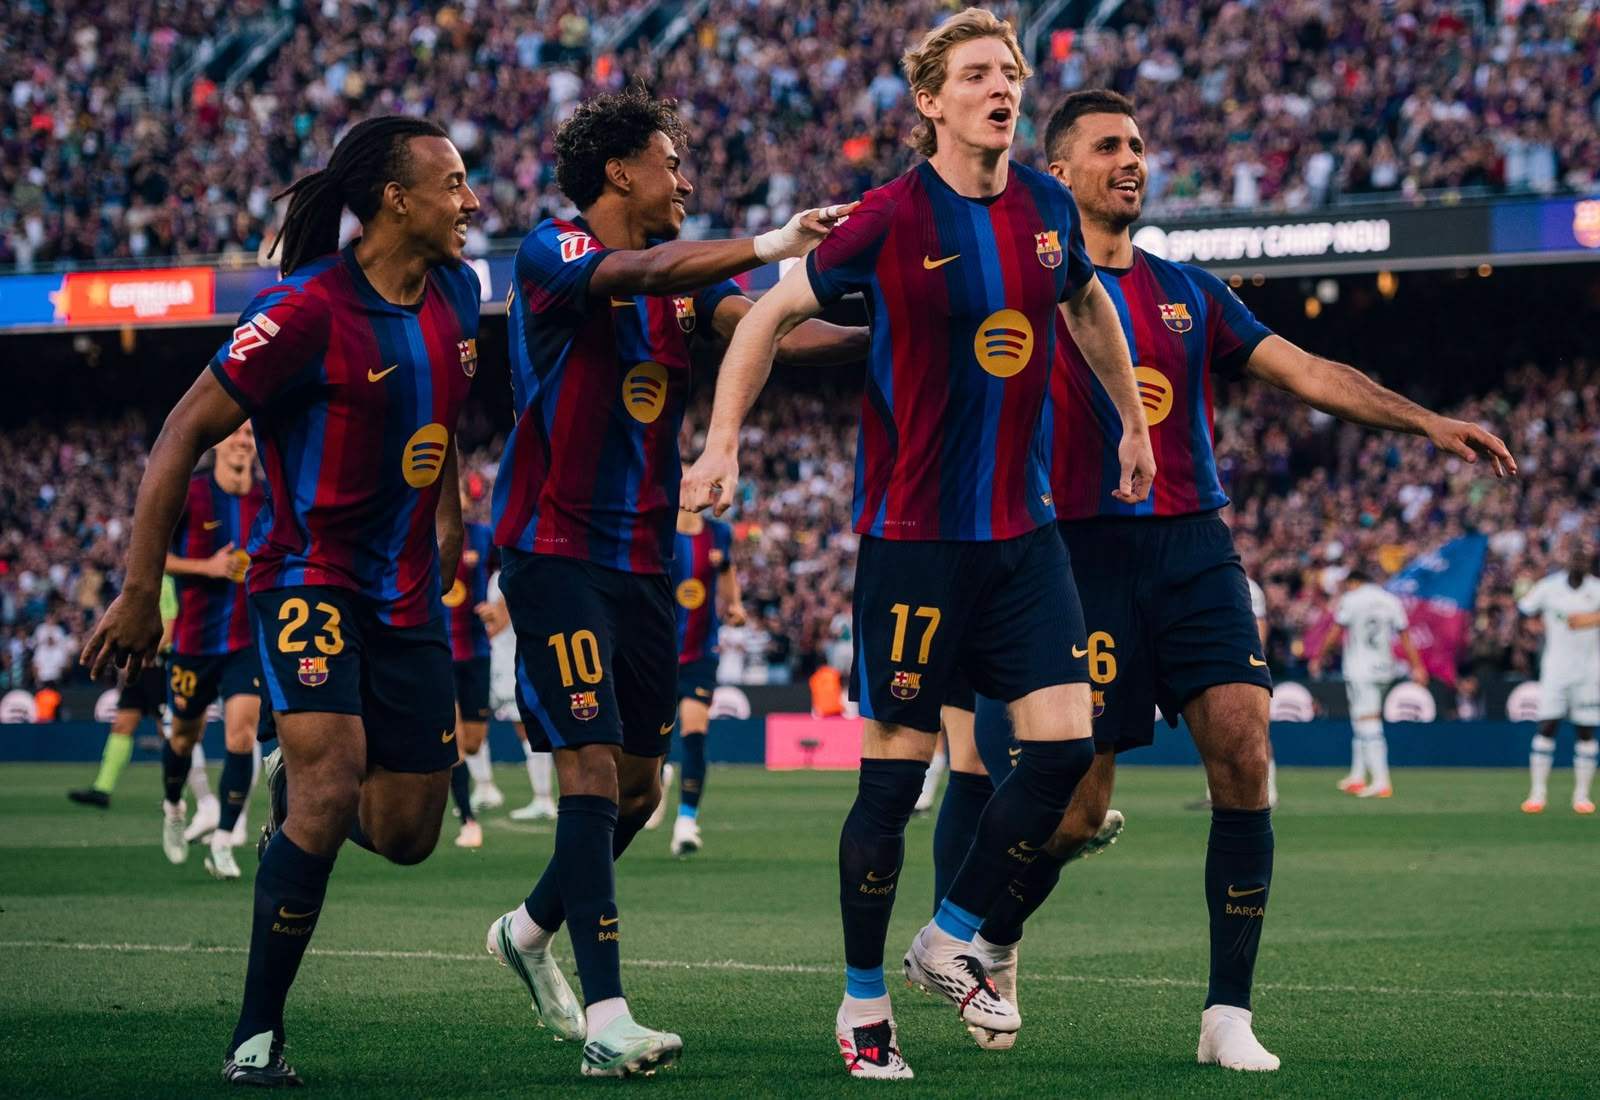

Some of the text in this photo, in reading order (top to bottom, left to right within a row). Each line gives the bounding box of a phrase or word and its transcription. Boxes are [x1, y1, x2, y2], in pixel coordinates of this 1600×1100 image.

[278, 597, 345, 655] 23
[889, 602, 941, 664] 17
[170, 664, 197, 697] 20
[547, 629, 603, 688] 10
[1087, 630, 1117, 684] 6
